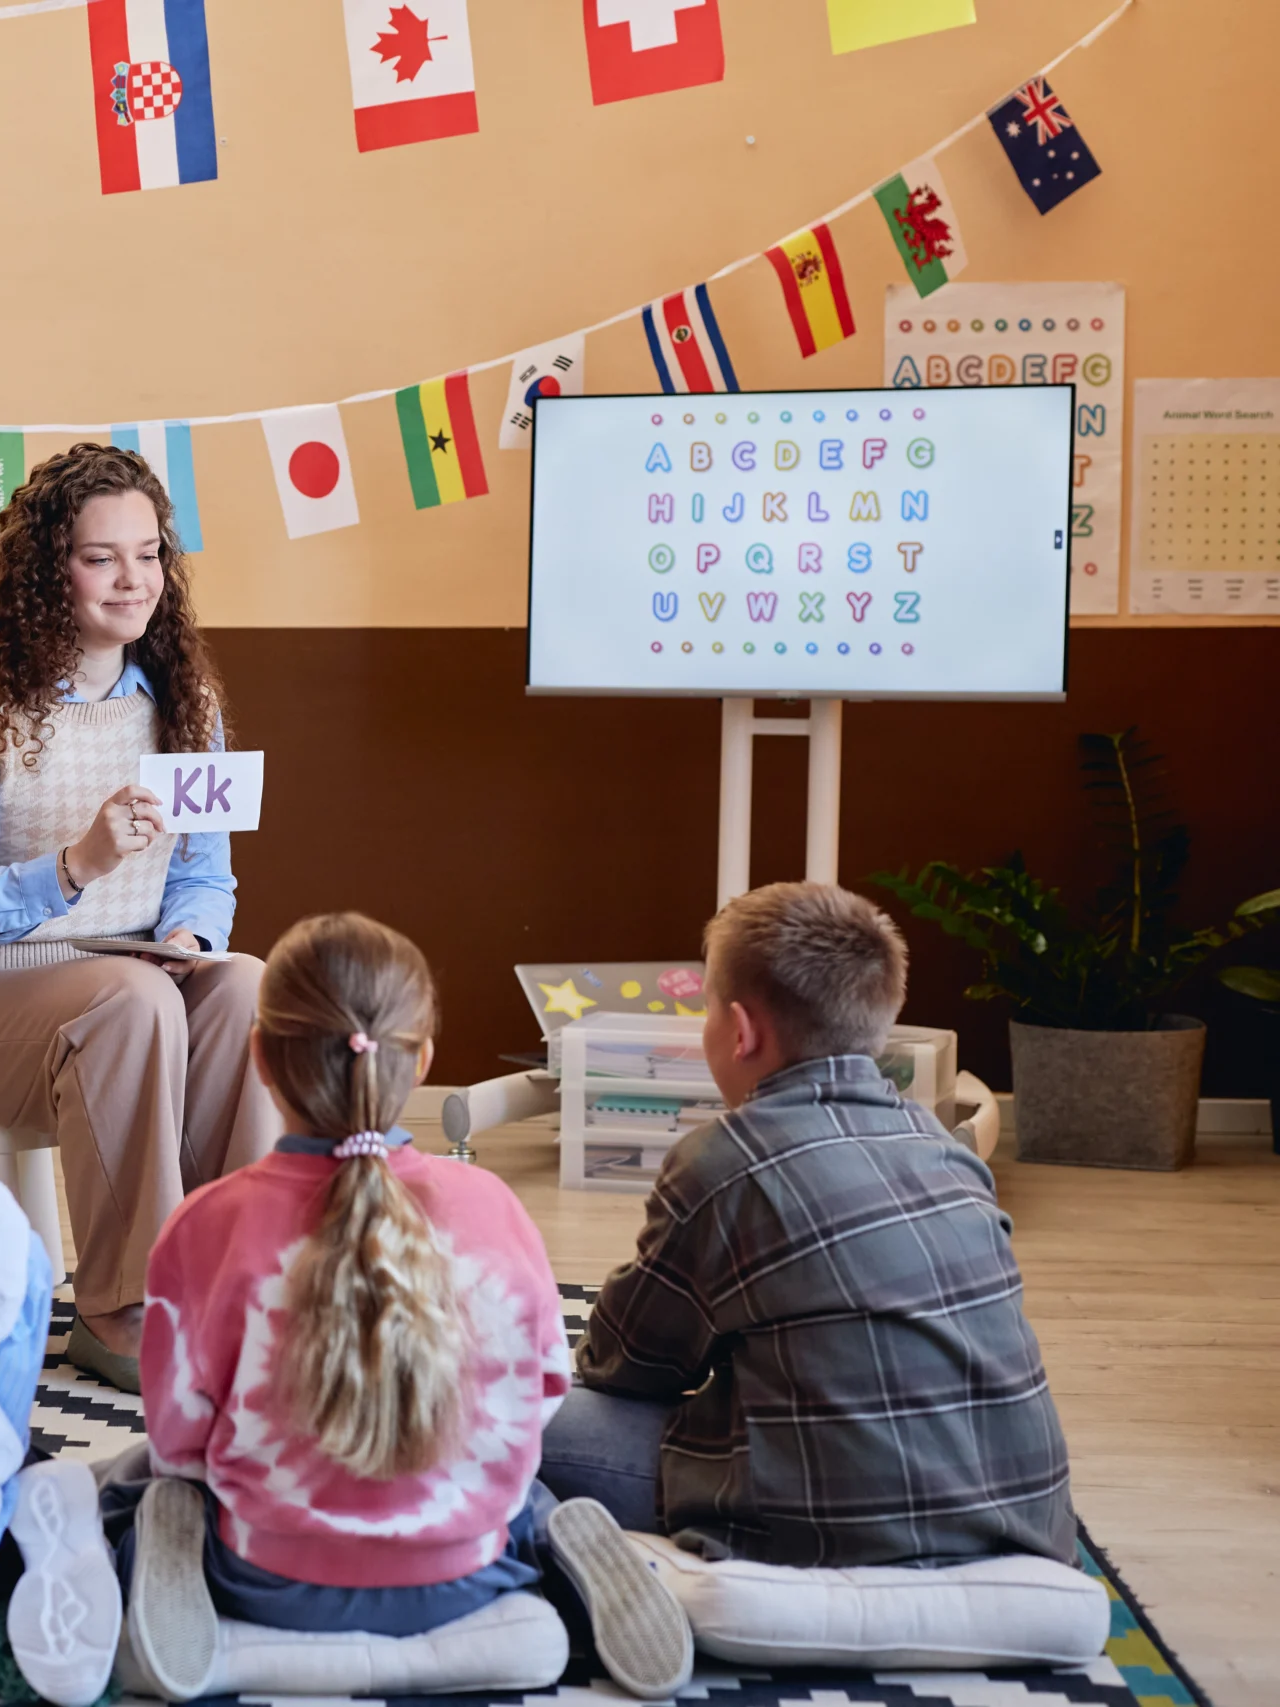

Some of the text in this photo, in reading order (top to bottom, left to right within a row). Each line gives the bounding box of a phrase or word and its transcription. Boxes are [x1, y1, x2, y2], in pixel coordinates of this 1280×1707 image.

[1163, 408, 1274, 420] Animal Word Search
[644, 437, 935, 474] A B C D E F G
[648, 489, 929, 524] H I J K L M N
[648, 541, 924, 575] O P Q R S T
[652, 591, 921, 624] U V W X Y Z
[172, 764, 232, 817] Kk
